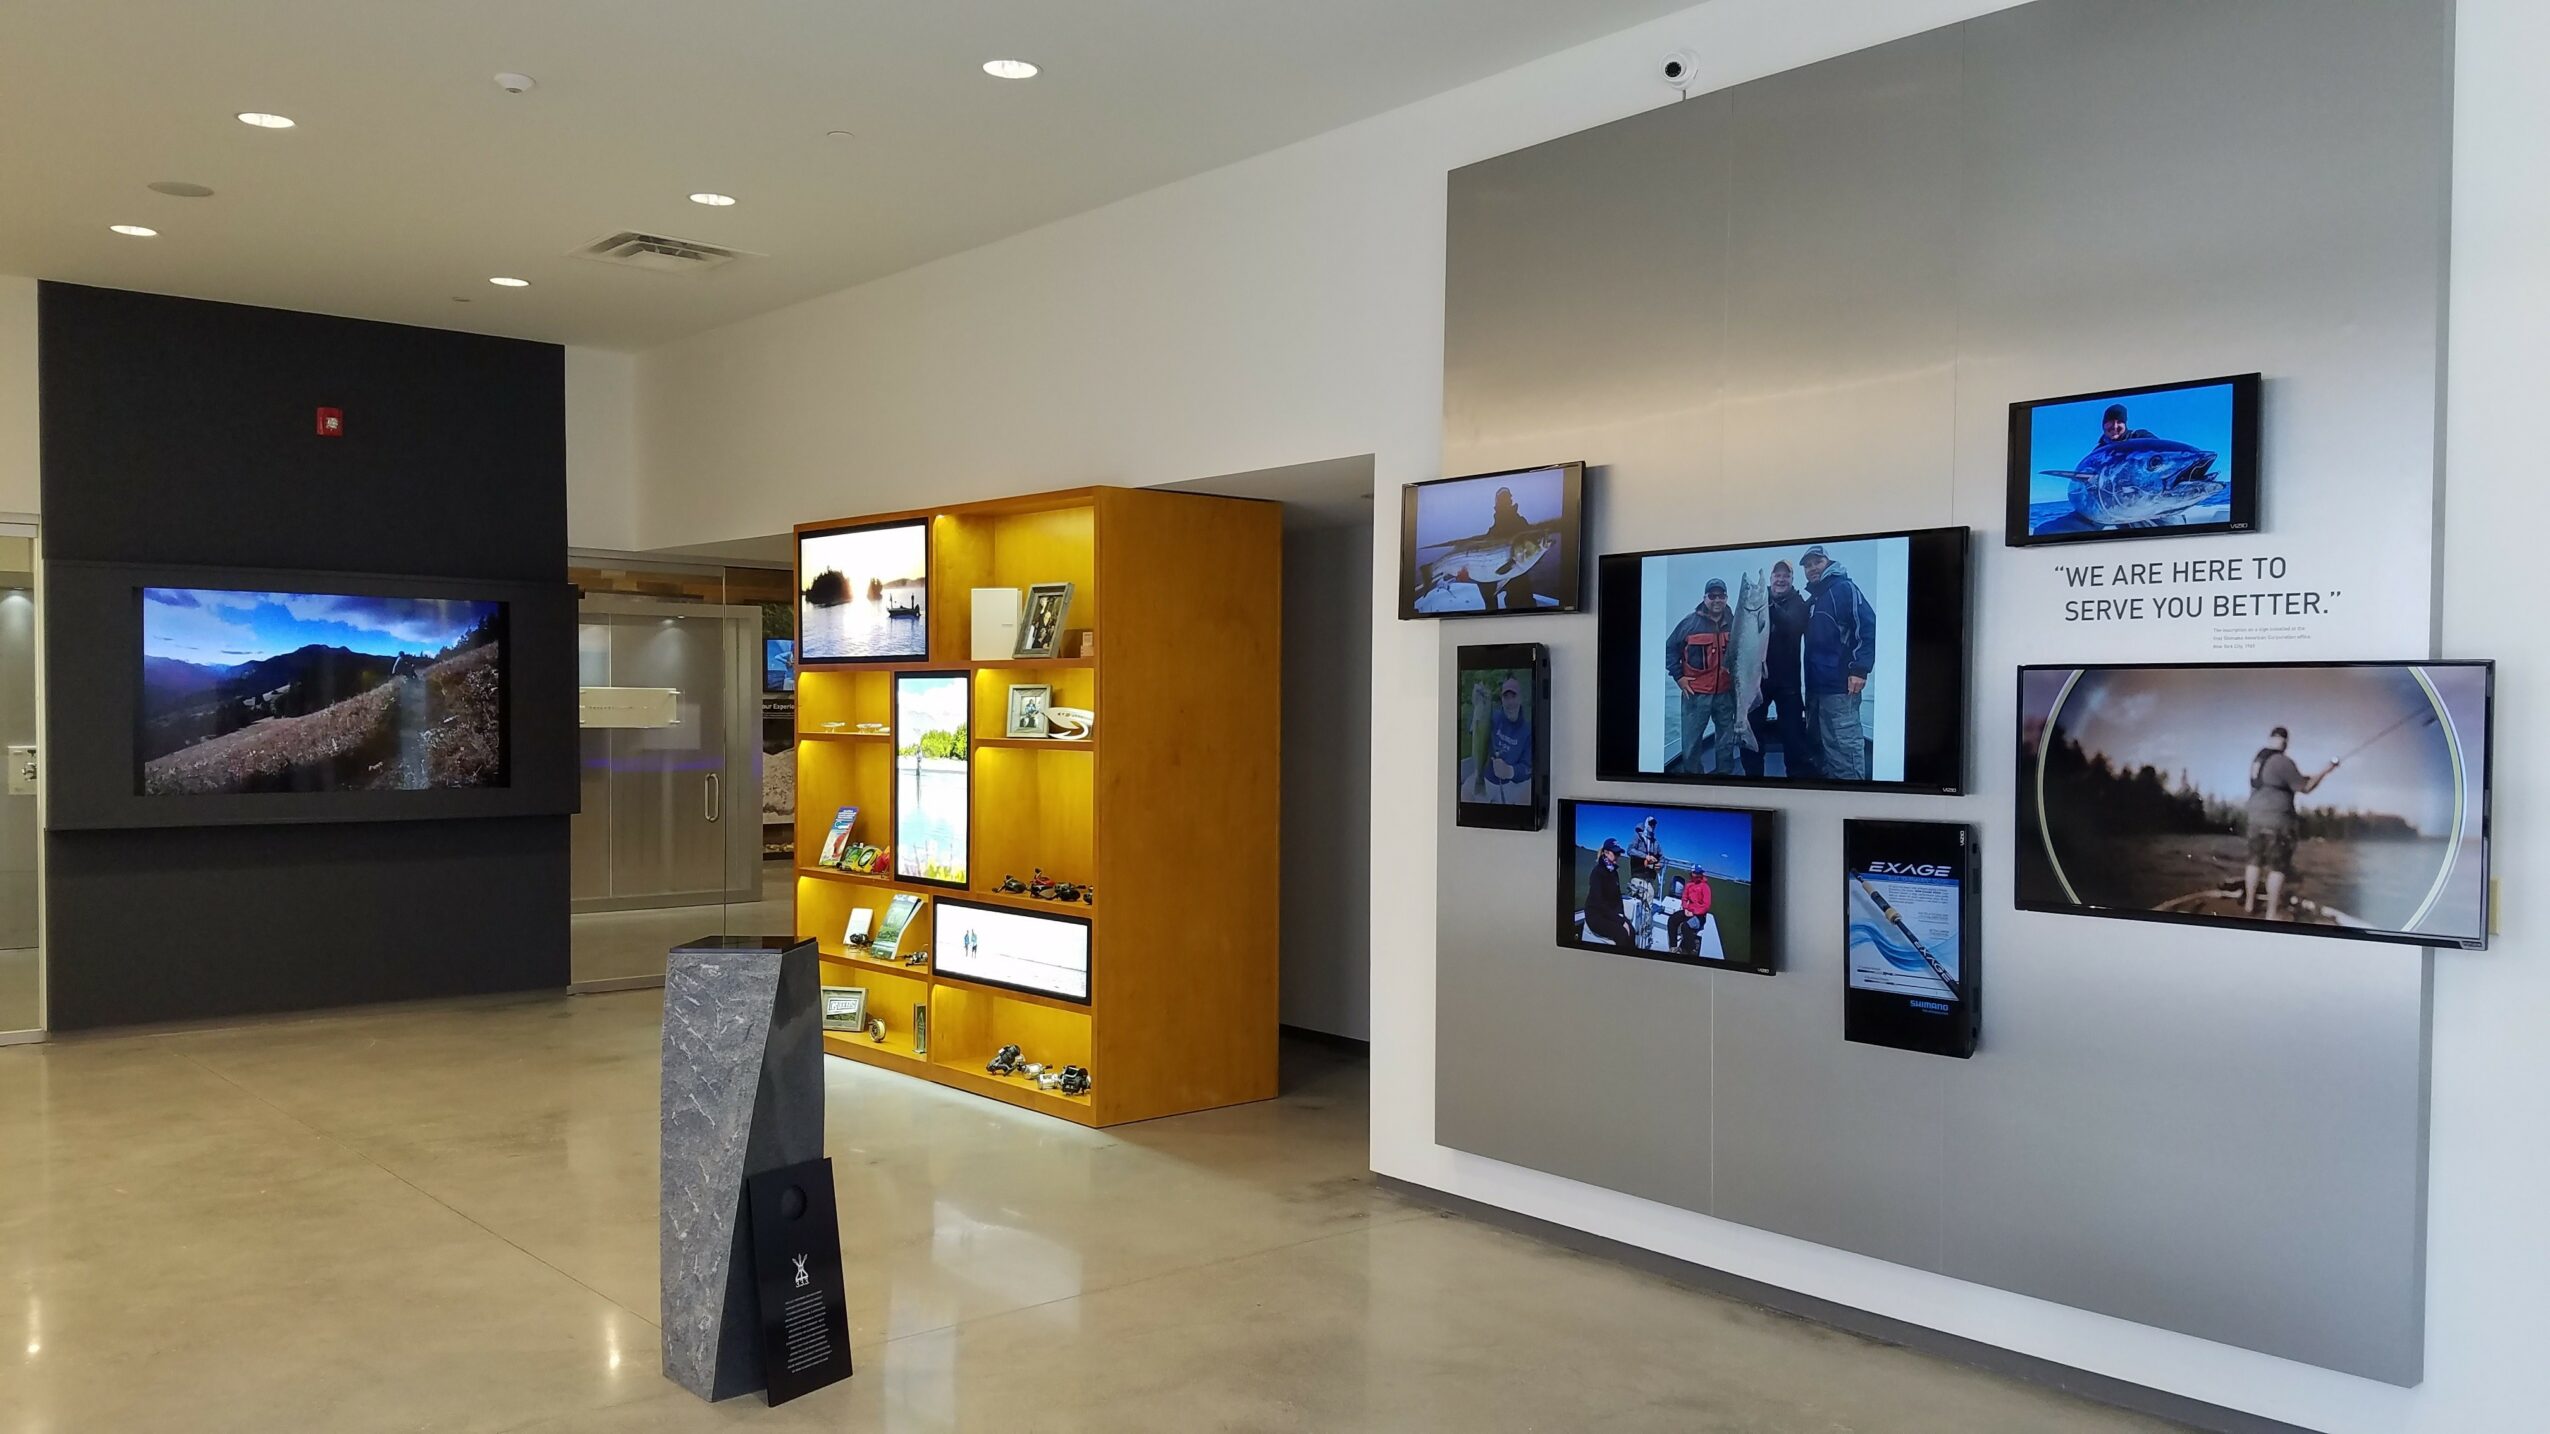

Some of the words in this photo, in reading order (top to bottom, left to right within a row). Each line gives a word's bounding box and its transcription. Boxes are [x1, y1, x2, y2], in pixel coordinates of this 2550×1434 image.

[2112, 562, 2163, 586] ARE
[2172, 558, 2243, 583] HERE
[2252, 556, 2287, 580] TO
[2064, 598, 2144, 622] SERVE
[2152, 595, 2202, 619] YOU
[1868, 861, 1952, 878] EXAGE
[1914, 941, 1953, 983] EXAGE
[1910, 999, 1949, 1011] SHIMANO
